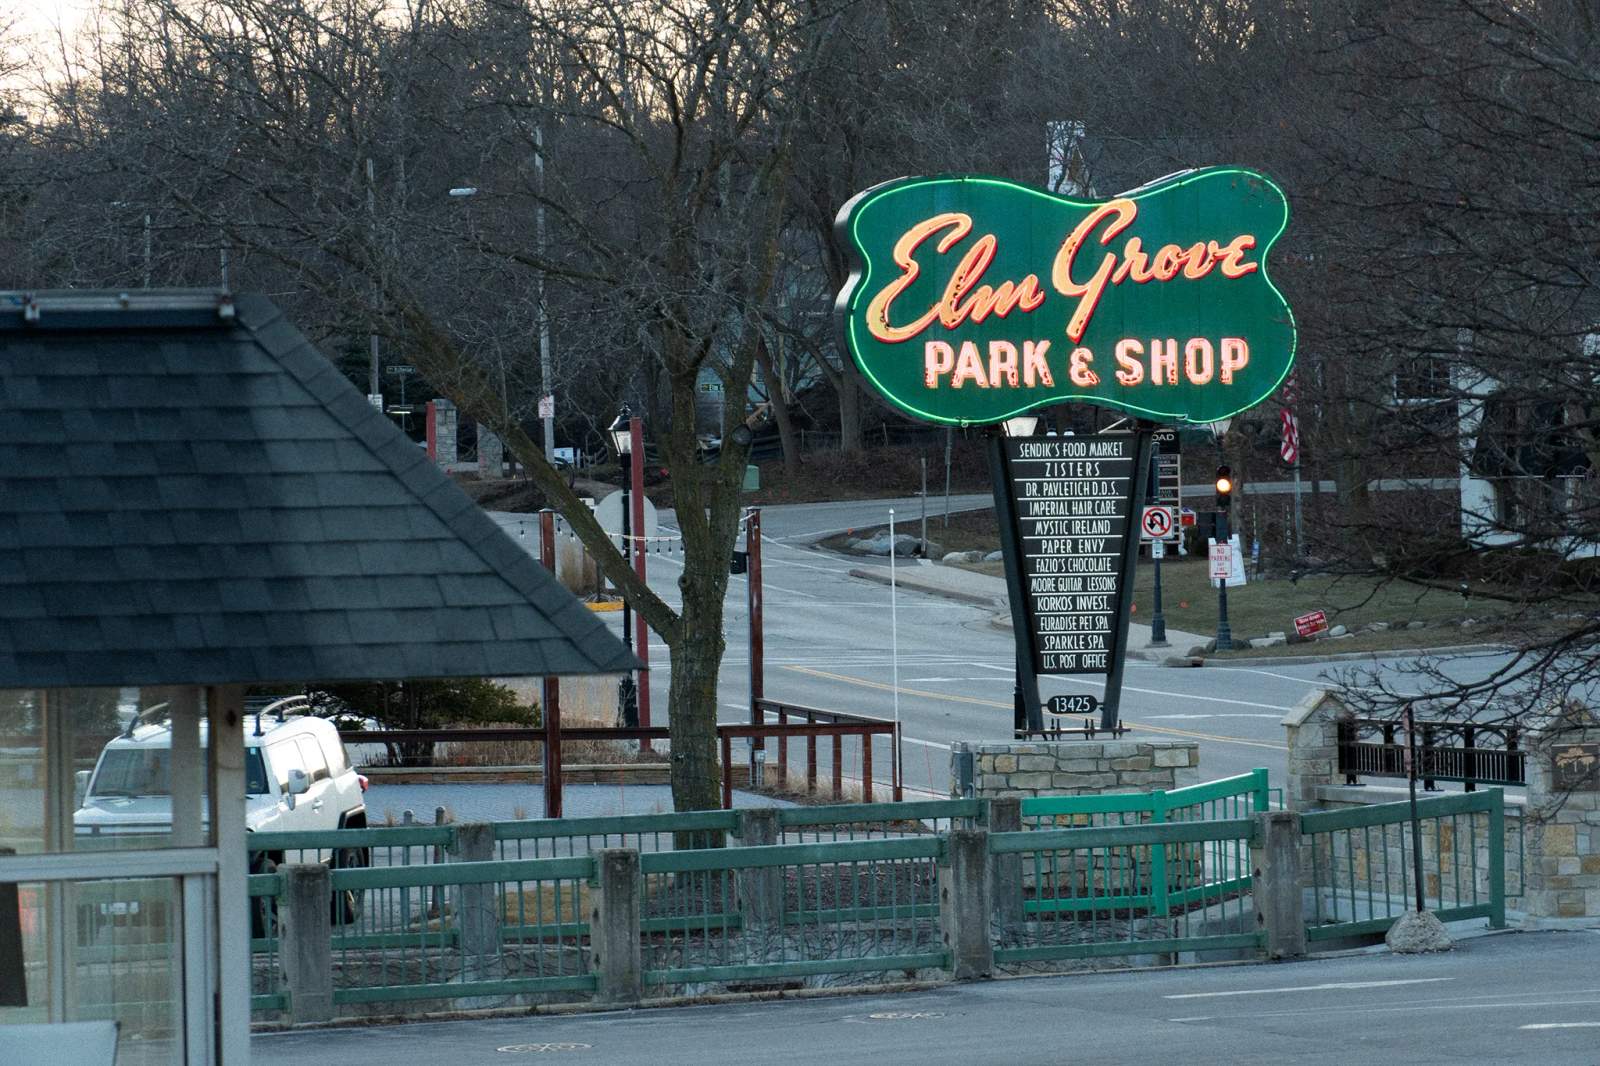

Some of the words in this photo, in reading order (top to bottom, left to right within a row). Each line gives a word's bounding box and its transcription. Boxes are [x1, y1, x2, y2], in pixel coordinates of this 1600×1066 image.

[865, 212, 1045, 342] Elm
[1052, 197, 1258, 344] Grove
[924, 339, 1054, 388] PARK
[1069, 347, 1101, 387] &
[1115, 337, 1249, 386] SHOP
[1020, 442, 1060, 458] SENDIK'S
[1063, 442, 1086, 457] FOOD
[1089, 441, 1123, 457] MARKET
[1045, 462, 1100, 477] ZISTERS
[1025, 482, 1040, 497] DR.
[1043, 481, 1090, 497] PAVLETICH
[1092, 481, 1119, 496] D.D.S.
[1029, 501, 1069, 516] IMPERIAL
[1072, 500, 1092, 515] HAIR
[1094, 500, 1116, 515] CARE
[1035, 520, 1068, 535] MYSTIC
[1071, 519, 1111, 535] IRELAND
[1042, 539, 1072, 554] PAPER
[1079, 538, 1105, 553] ENVY
[1036, 558, 1066, 573] FAZIO'S
[1068, 557, 1112, 572] CHOCOLATE
[1031, 577, 1055, 592] MOORE
[1058, 577, 1082, 592] GUITAR
[1087, 576, 1116, 591] LESSONS
[1037, 596, 1072, 611] KORKOS
[1076, 595, 1110, 611] INVEST.
[1040, 616, 1077, 631] FURADISE
[1079, 616, 1093, 630] PET
[1095, 615, 1108, 630] SPA
[1044, 635, 1085, 650] SPARKLE
[1087, 634, 1104, 649] SPA
[1043, 655, 1057, 669] U.S.
[1060, 654, 1076, 669] POST
[1082, 653, 1107, 668] OFFICE
[1054, 697, 1090, 712] 13425
